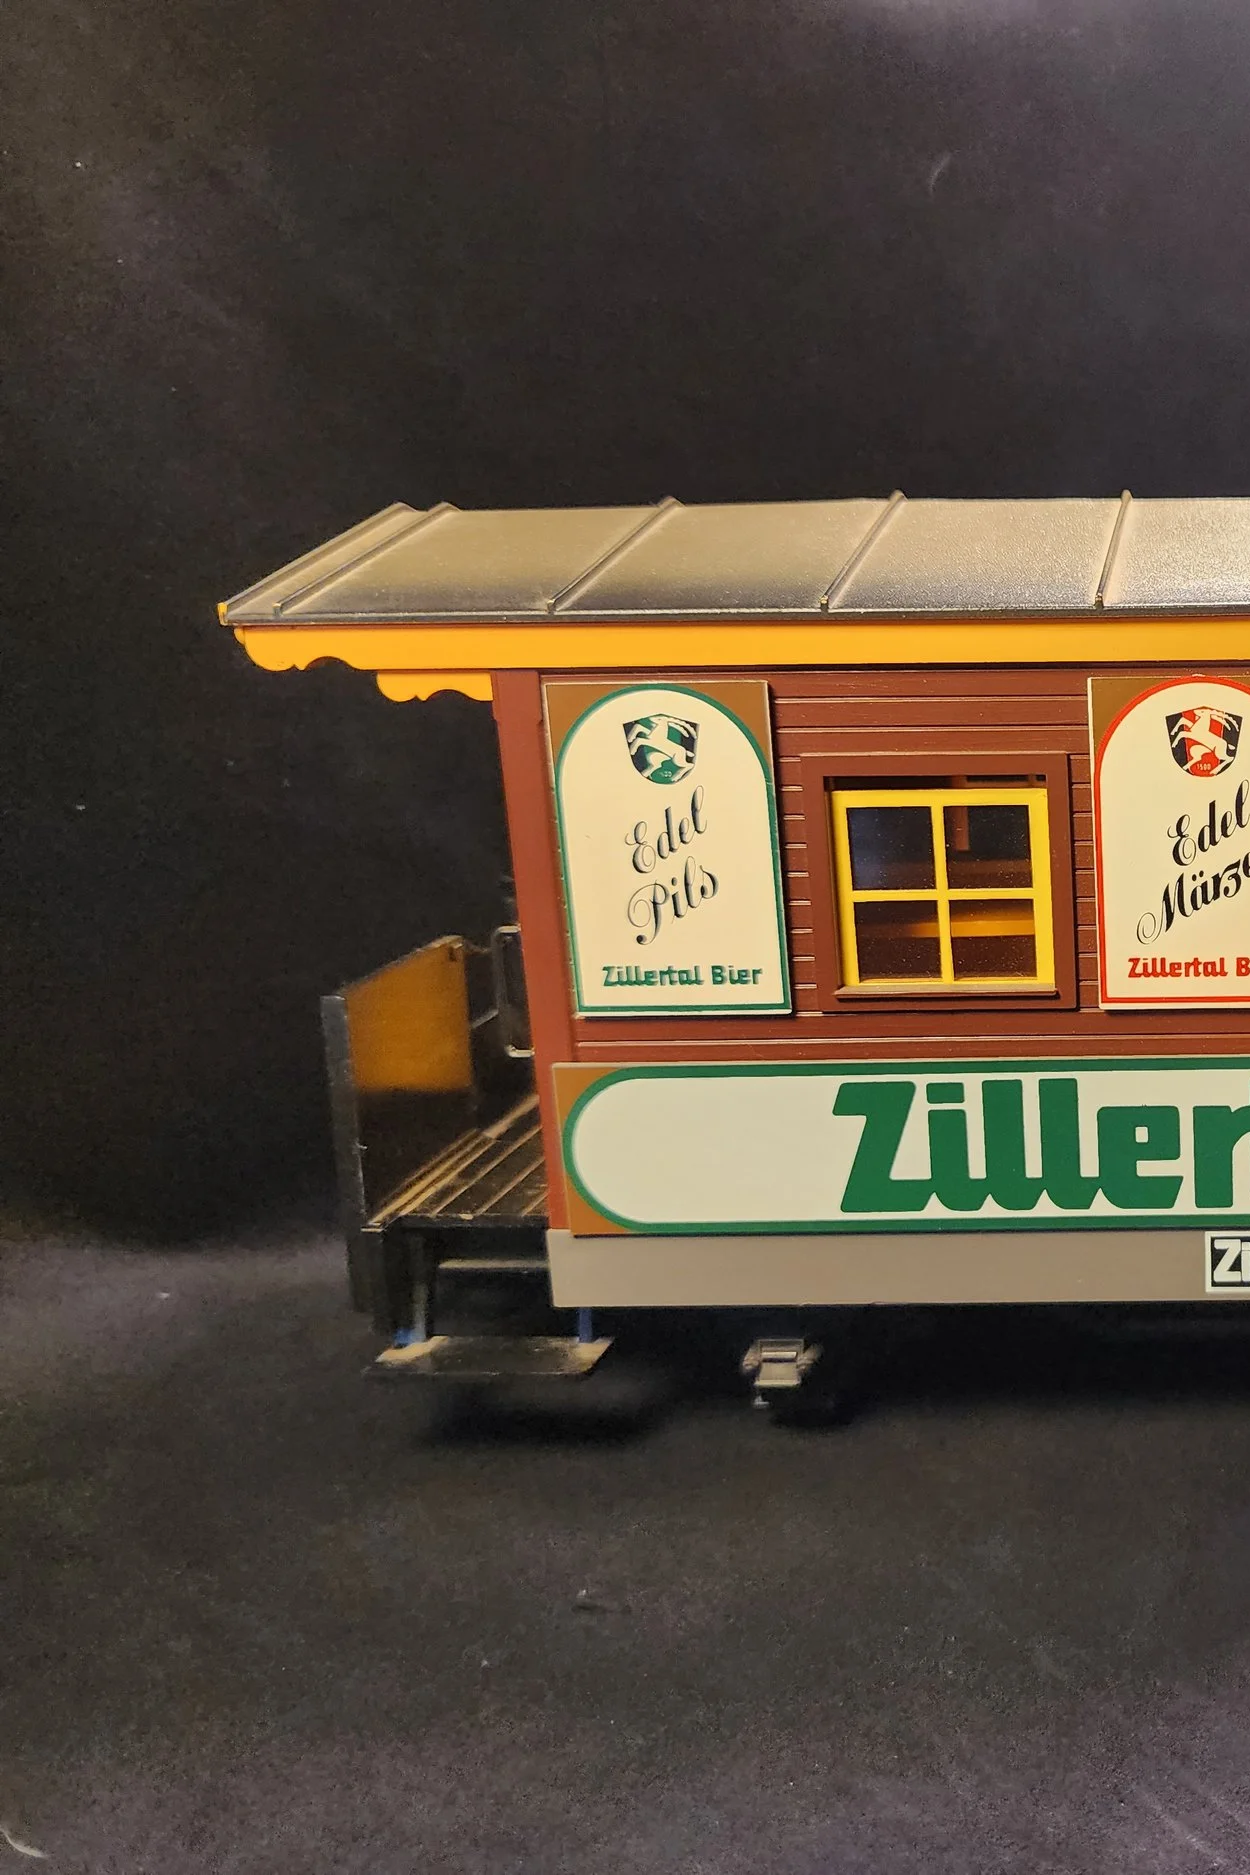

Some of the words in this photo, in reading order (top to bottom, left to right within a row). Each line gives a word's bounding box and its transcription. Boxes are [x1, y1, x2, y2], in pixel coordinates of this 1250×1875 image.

[624, 785, 708, 873] Edel
[1167, 779, 1250, 866] Edel
[627, 856, 719, 945] Pils
[602, 965, 704, 987] Zillertal
[711, 965, 763, 986] Bier
[1128, 957, 1229, 979] Zillertal
